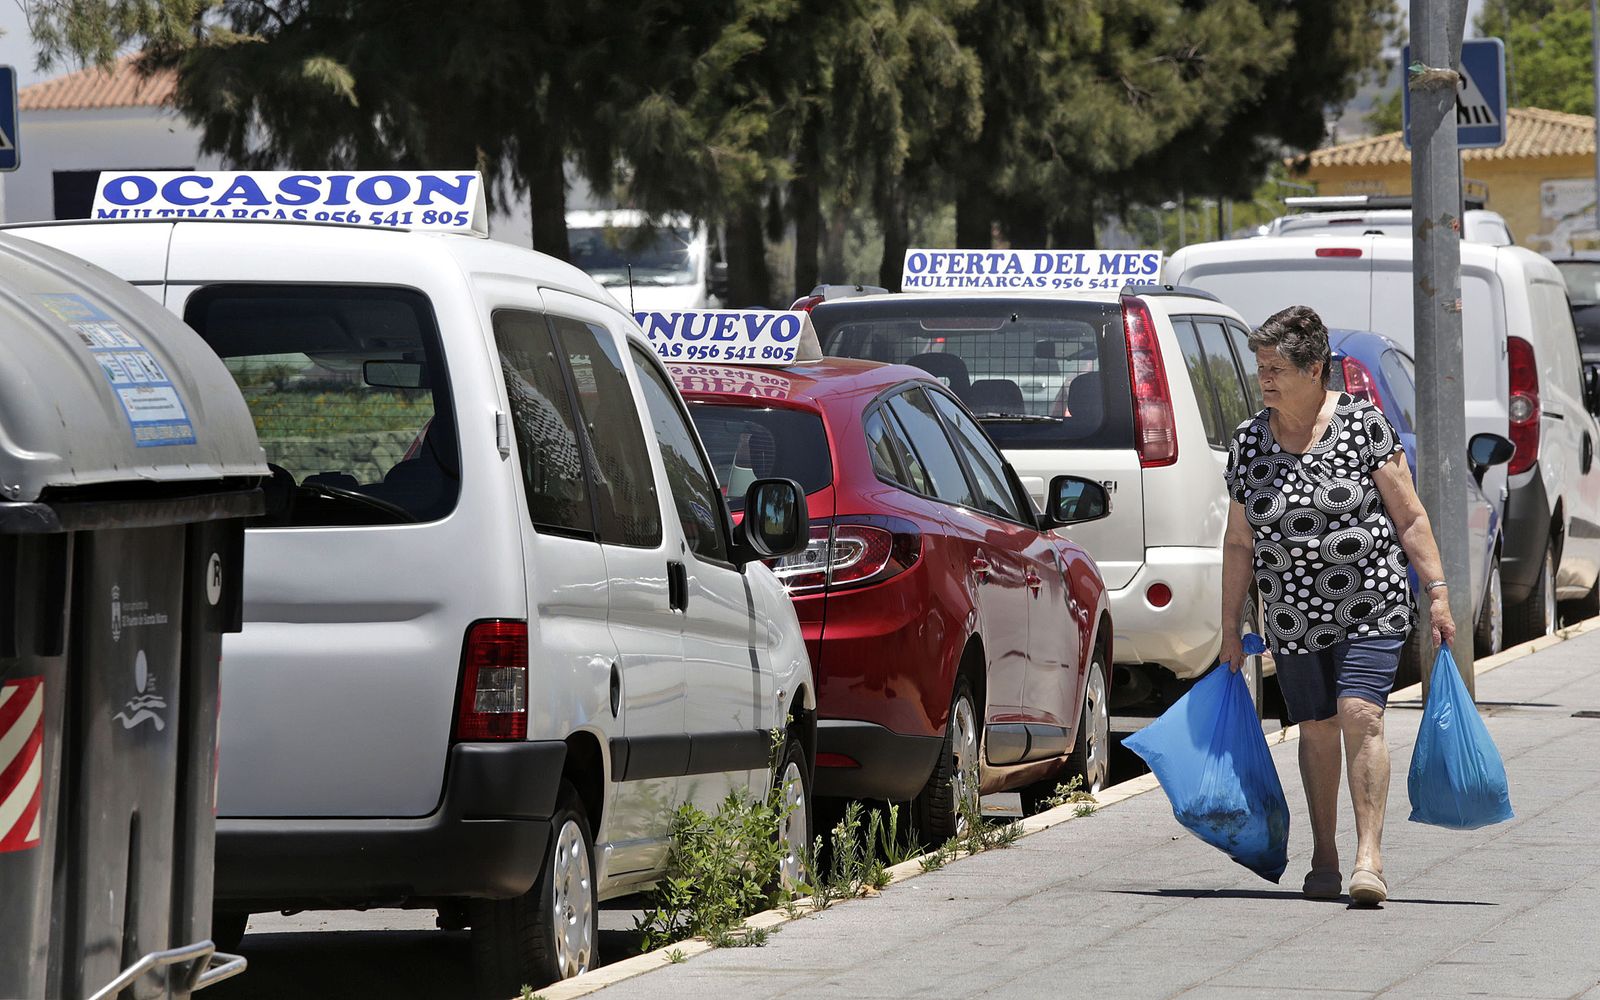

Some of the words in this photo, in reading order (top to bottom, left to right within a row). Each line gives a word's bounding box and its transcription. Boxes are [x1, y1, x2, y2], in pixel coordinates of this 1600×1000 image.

[102, 174, 476, 206] OCASION
[314, 210, 362, 223] 956
[369, 211, 412, 227] 541
[421, 210, 470, 227] 805
[907, 252, 1024, 275] OFERTA
[1032, 252, 1090, 275] DEL
[1097, 253, 1159, 276] MES
[904, 276, 1047, 289] MULTIMARCAS
[1051, 278, 1083, 289] 956
[1088, 278, 1118, 289] 541
[687, 345, 720, 360] 956
[724, 346, 756, 361] 541
[761, 346, 796, 361] 805
